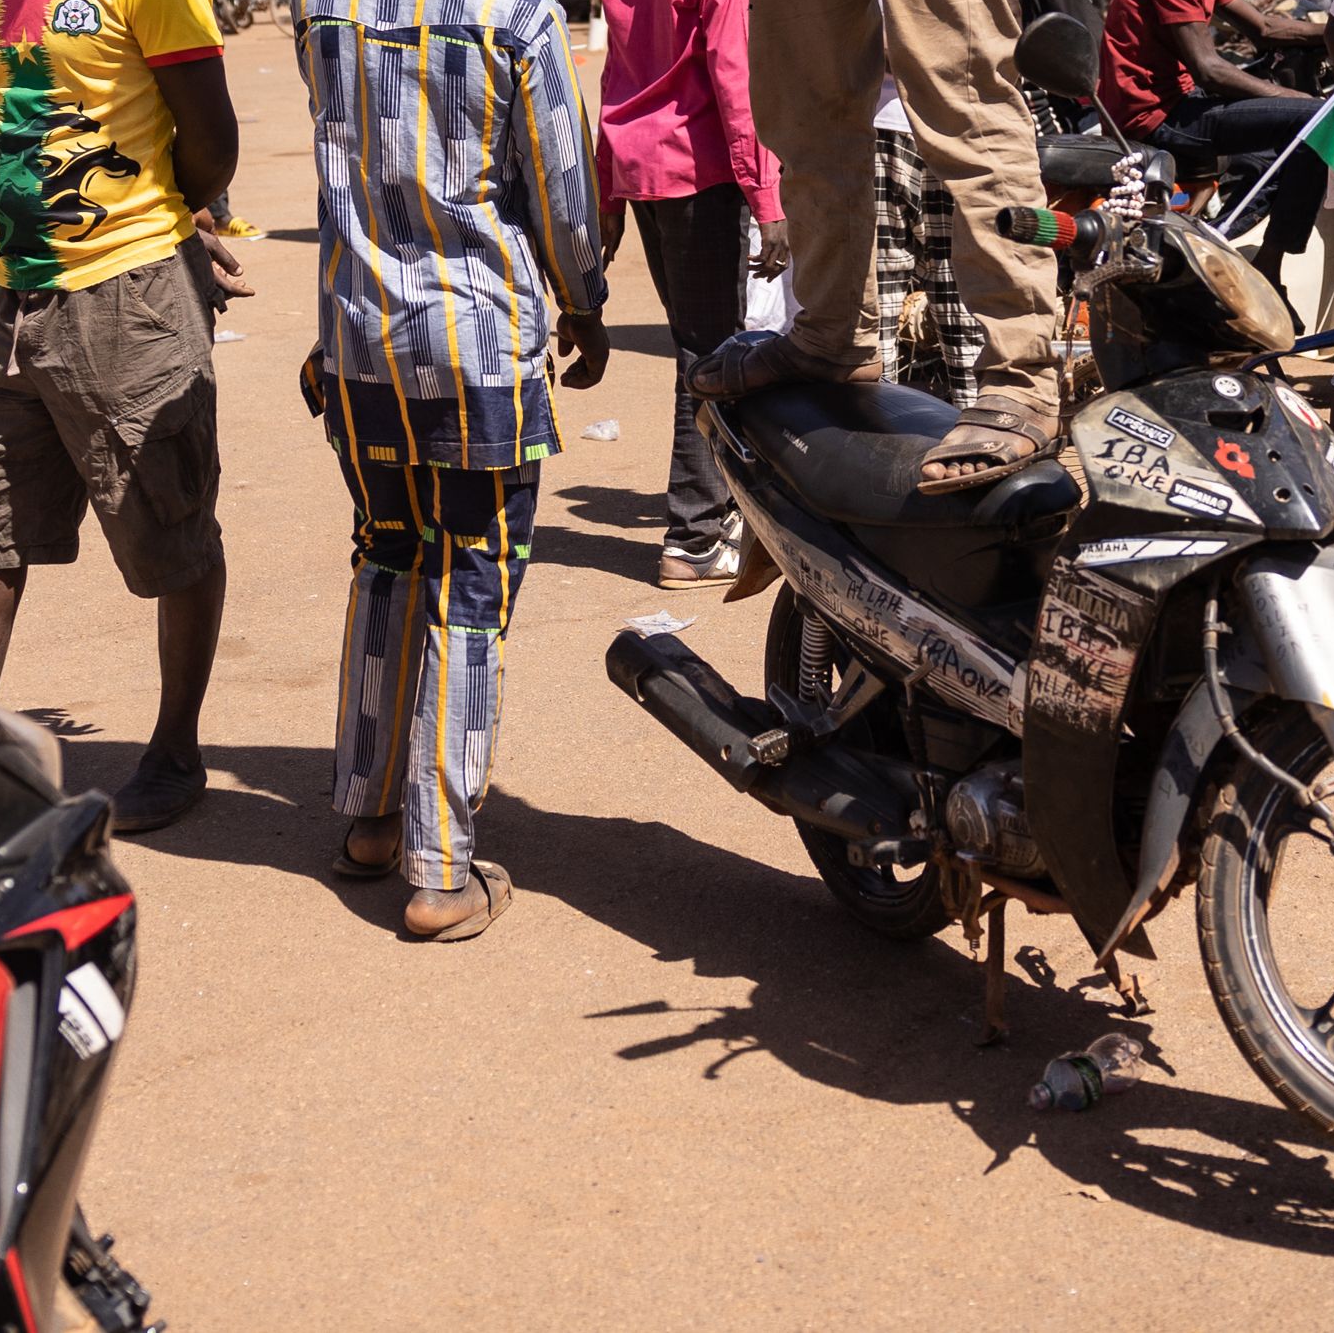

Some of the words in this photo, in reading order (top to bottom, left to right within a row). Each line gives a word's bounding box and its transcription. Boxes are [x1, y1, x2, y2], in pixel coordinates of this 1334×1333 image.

[1114, 414, 1169, 443] APSONIC
[1092, 437, 1169, 475] IBA
[1174, 483, 1219, 508] YAMAHA
[1080, 543, 1129, 553] YAMAHA
[846, 580, 903, 613] ALLAH
[1058, 584, 1129, 631] YAMAHA
[853, 618, 892, 652] ONE
[960, 669, 1010, 701] ONE
[1030, 670, 1087, 704] ALLAH
